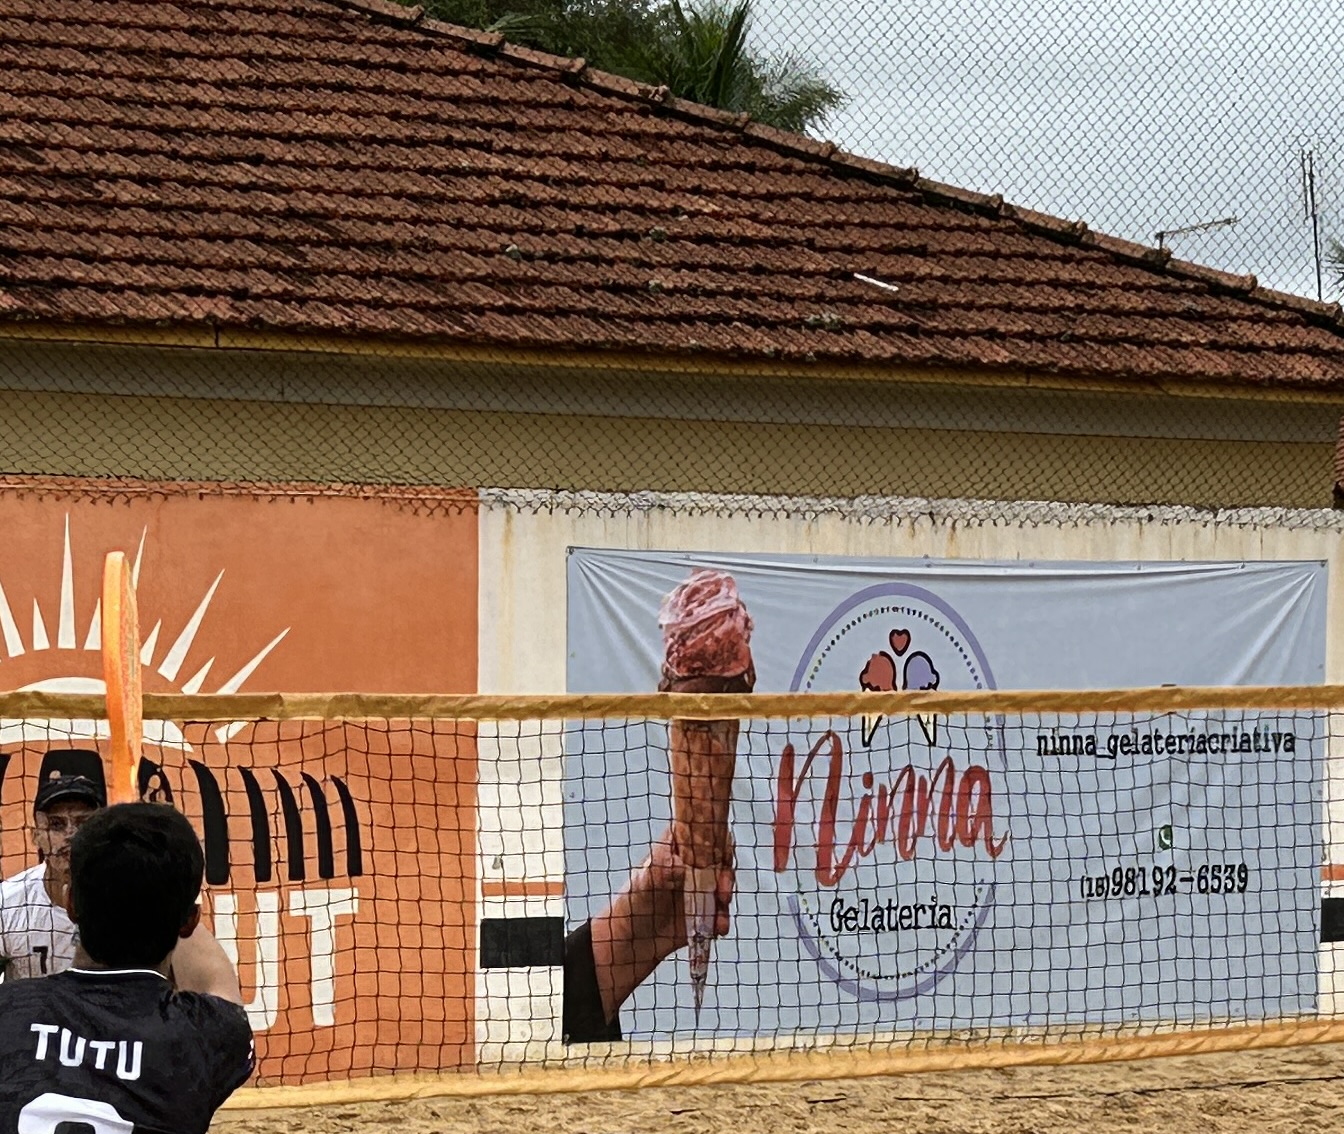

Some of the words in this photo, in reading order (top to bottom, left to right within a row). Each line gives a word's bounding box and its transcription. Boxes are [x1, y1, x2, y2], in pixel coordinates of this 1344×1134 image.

[773, 729, 1009, 887] Ninna
[830, 895, 956, 932] Gelateria
[30, 1023, 144, 1080] TUTU
